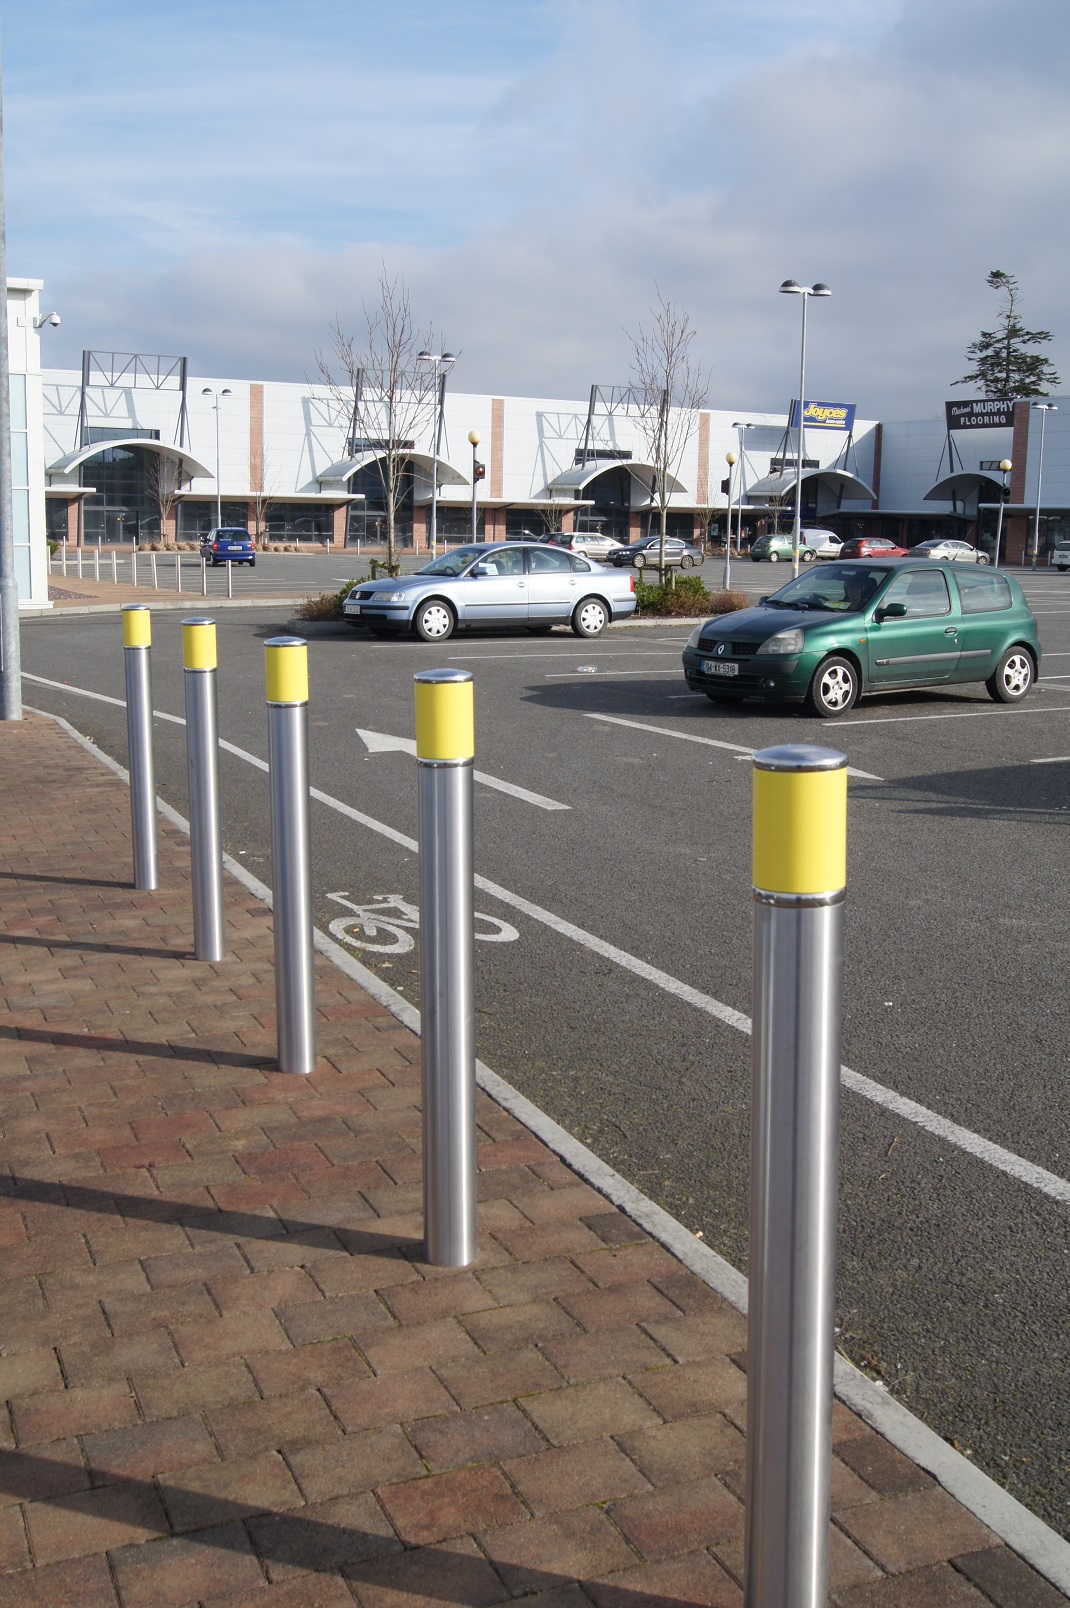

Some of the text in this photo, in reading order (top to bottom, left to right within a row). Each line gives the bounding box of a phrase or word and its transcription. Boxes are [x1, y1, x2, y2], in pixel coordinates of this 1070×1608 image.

[804, 403, 848, 421] Joyces
[973, 401, 1014, 413] MURPHY
[960, 415, 1006, 425] FLOORING
